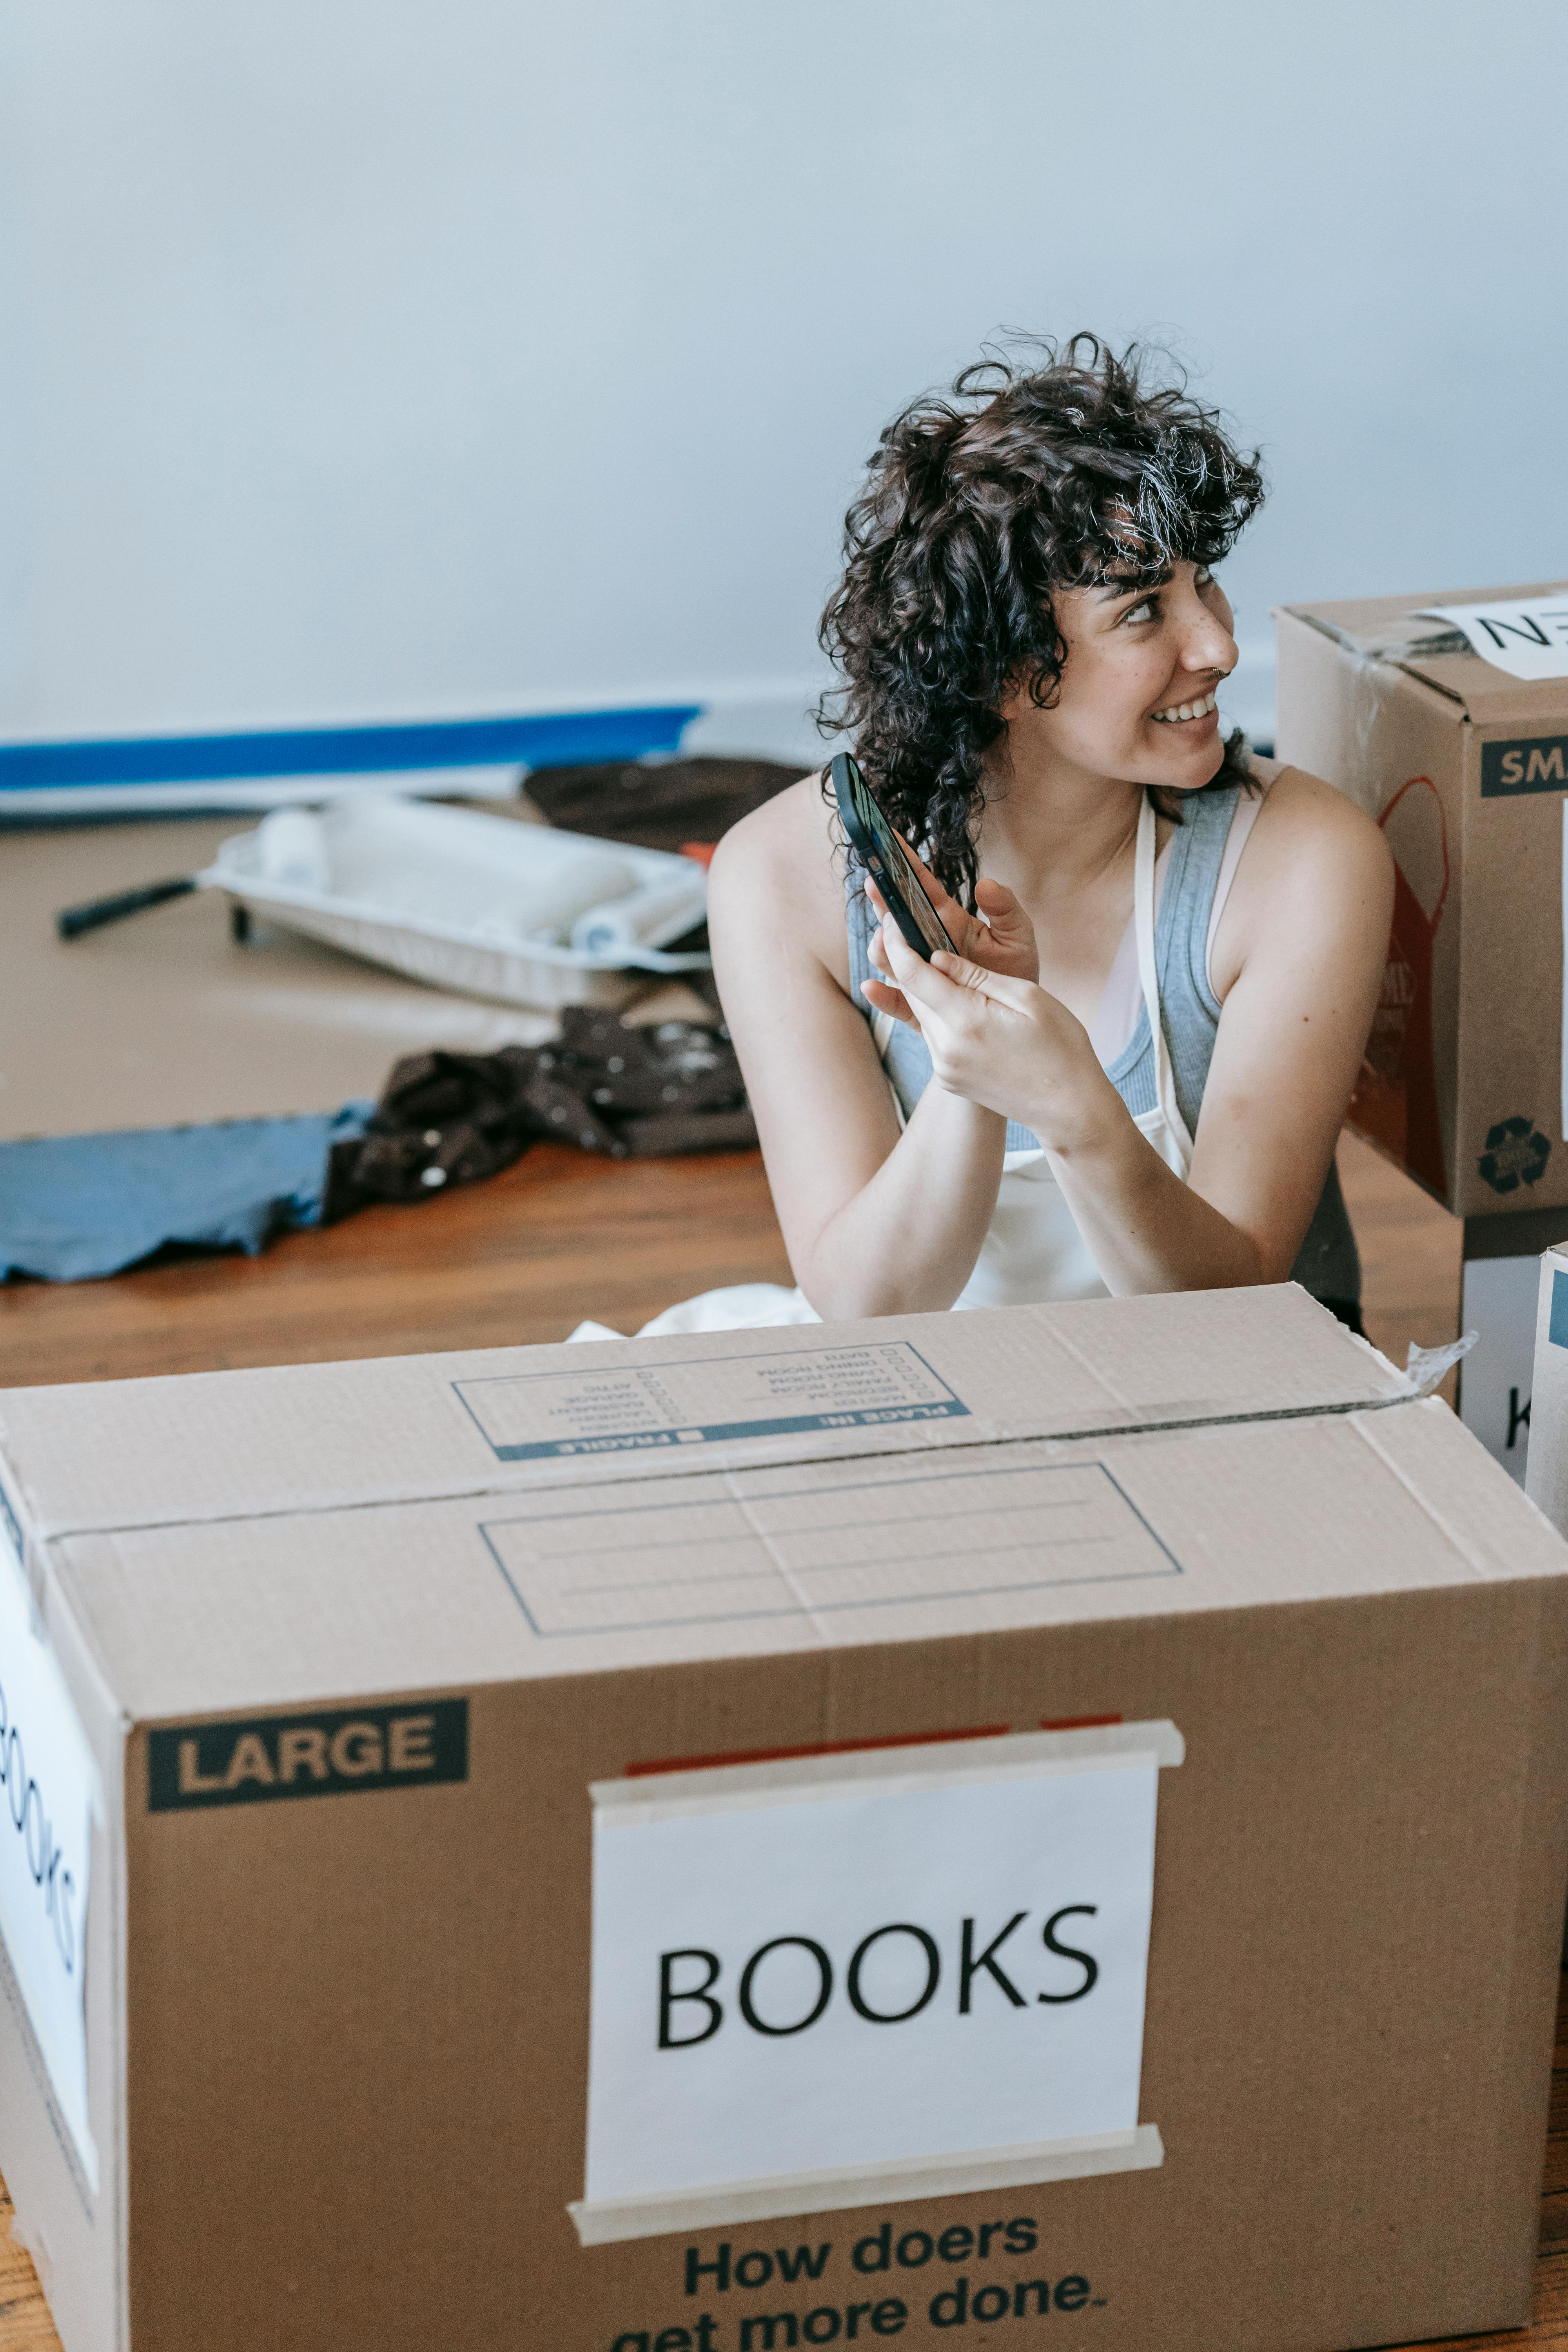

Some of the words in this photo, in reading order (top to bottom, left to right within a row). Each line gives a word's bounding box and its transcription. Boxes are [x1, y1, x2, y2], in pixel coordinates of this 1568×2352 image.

[1501, 746, 1568, 784] SM
[757, 1366, 811, 1376] ROOM
[817, 1360, 877, 1371] DINING
[768, 1374, 822, 1385] ROOM
[828, 1368, 884, 1379] LIVING
[771, 1383, 825, 1394] ROOM
[832, 1377, 891, 1388] FAMILY
[808, 1386, 898, 1399] BEDROOM
[833, 1394, 906, 1407] MASTER
[819, 1415, 856, 1427] IN:
[861, 1406, 949, 1423] PLACE
[557, 1434, 671, 1454] FRAGILE
[178, 1714, 437, 1794] LARGE
[658, 1905, 1099, 2050] BOOKS
[684, 2241, 833, 2296] How
[851, 2217, 1038, 2274] doers
[739, 2296, 908, 2352] more
